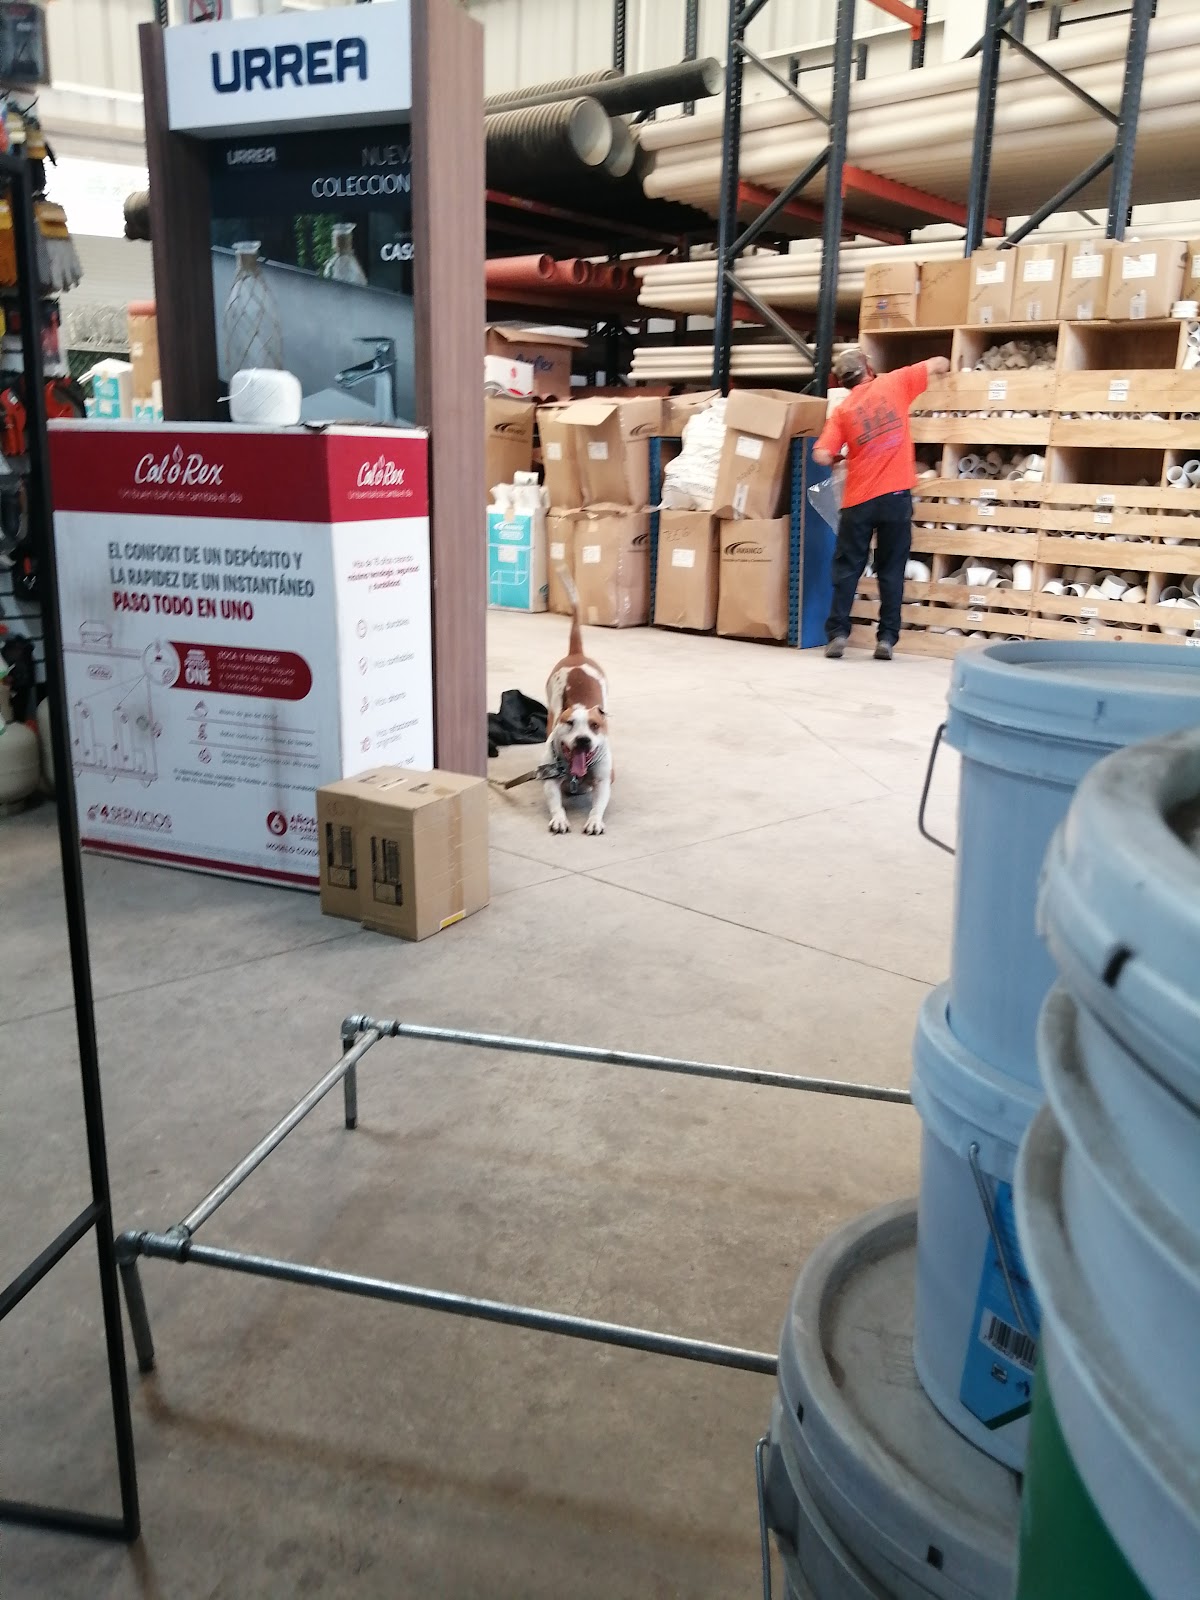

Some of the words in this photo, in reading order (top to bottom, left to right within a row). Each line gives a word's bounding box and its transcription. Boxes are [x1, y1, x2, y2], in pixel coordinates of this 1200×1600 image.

[211, 37, 368, 94] URREA
[227, 147, 277, 165] URREA
[108, 542, 122, 559] EL
[124, 542, 182, 563] CONFORT
[183, 545, 201, 564] DE
[202, 546, 221, 566] UN
[224, 545, 291, 570] DEPÓSITO
[292, 552, 302, 570] Y
[110, 566, 126, 585] LA
[128, 568, 180, 588] RAPIDEZ
[182, 571, 200, 590] DE
[201, 572, 220, 592] UN
[222, 573, 315, 598] INSTANTÁNEO
[112, 590, 150, 612] PASO
[152, 593, 193, 616] TODO
[197, 597, 217, 619] EN
[220, 599, 254, 621] UNO
